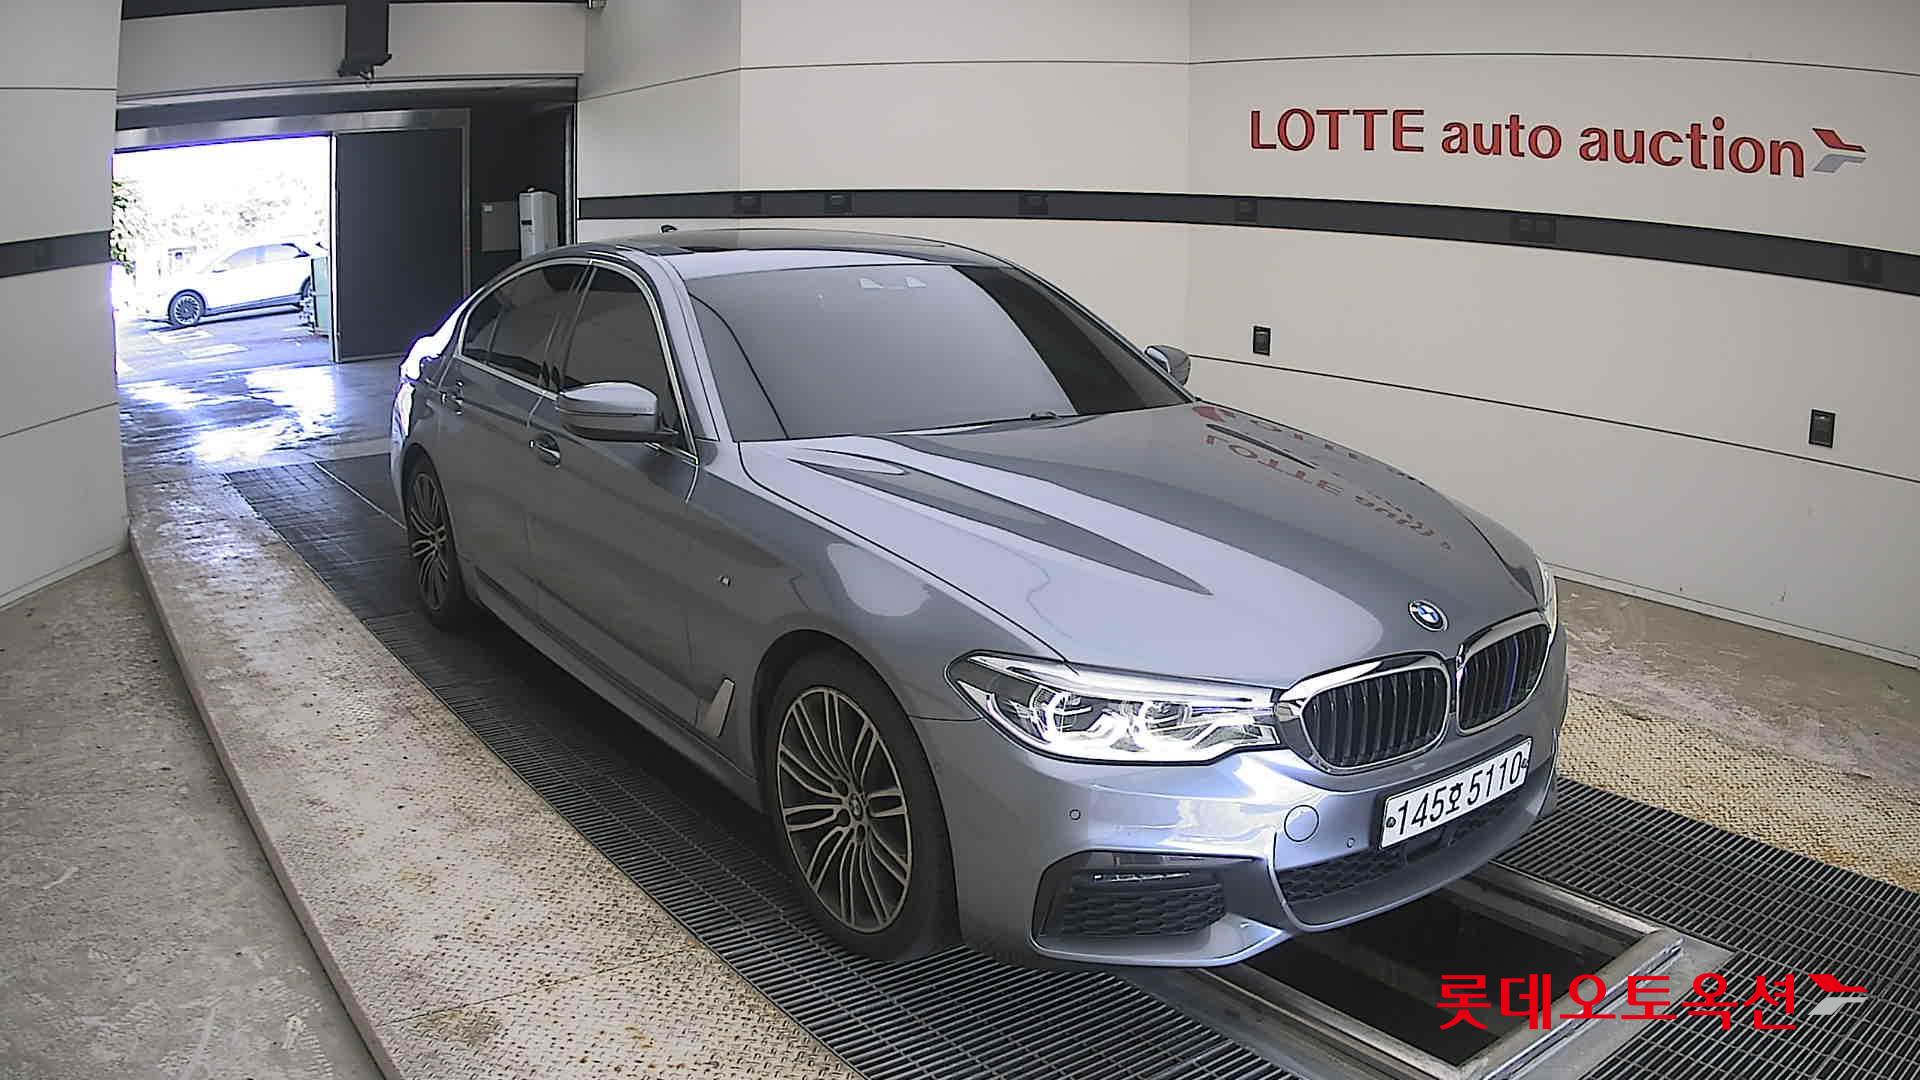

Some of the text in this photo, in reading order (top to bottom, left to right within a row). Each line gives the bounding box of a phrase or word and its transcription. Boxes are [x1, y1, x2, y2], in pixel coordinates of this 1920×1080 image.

[1250, 108, 1806, 178] LOTTE auto auction
